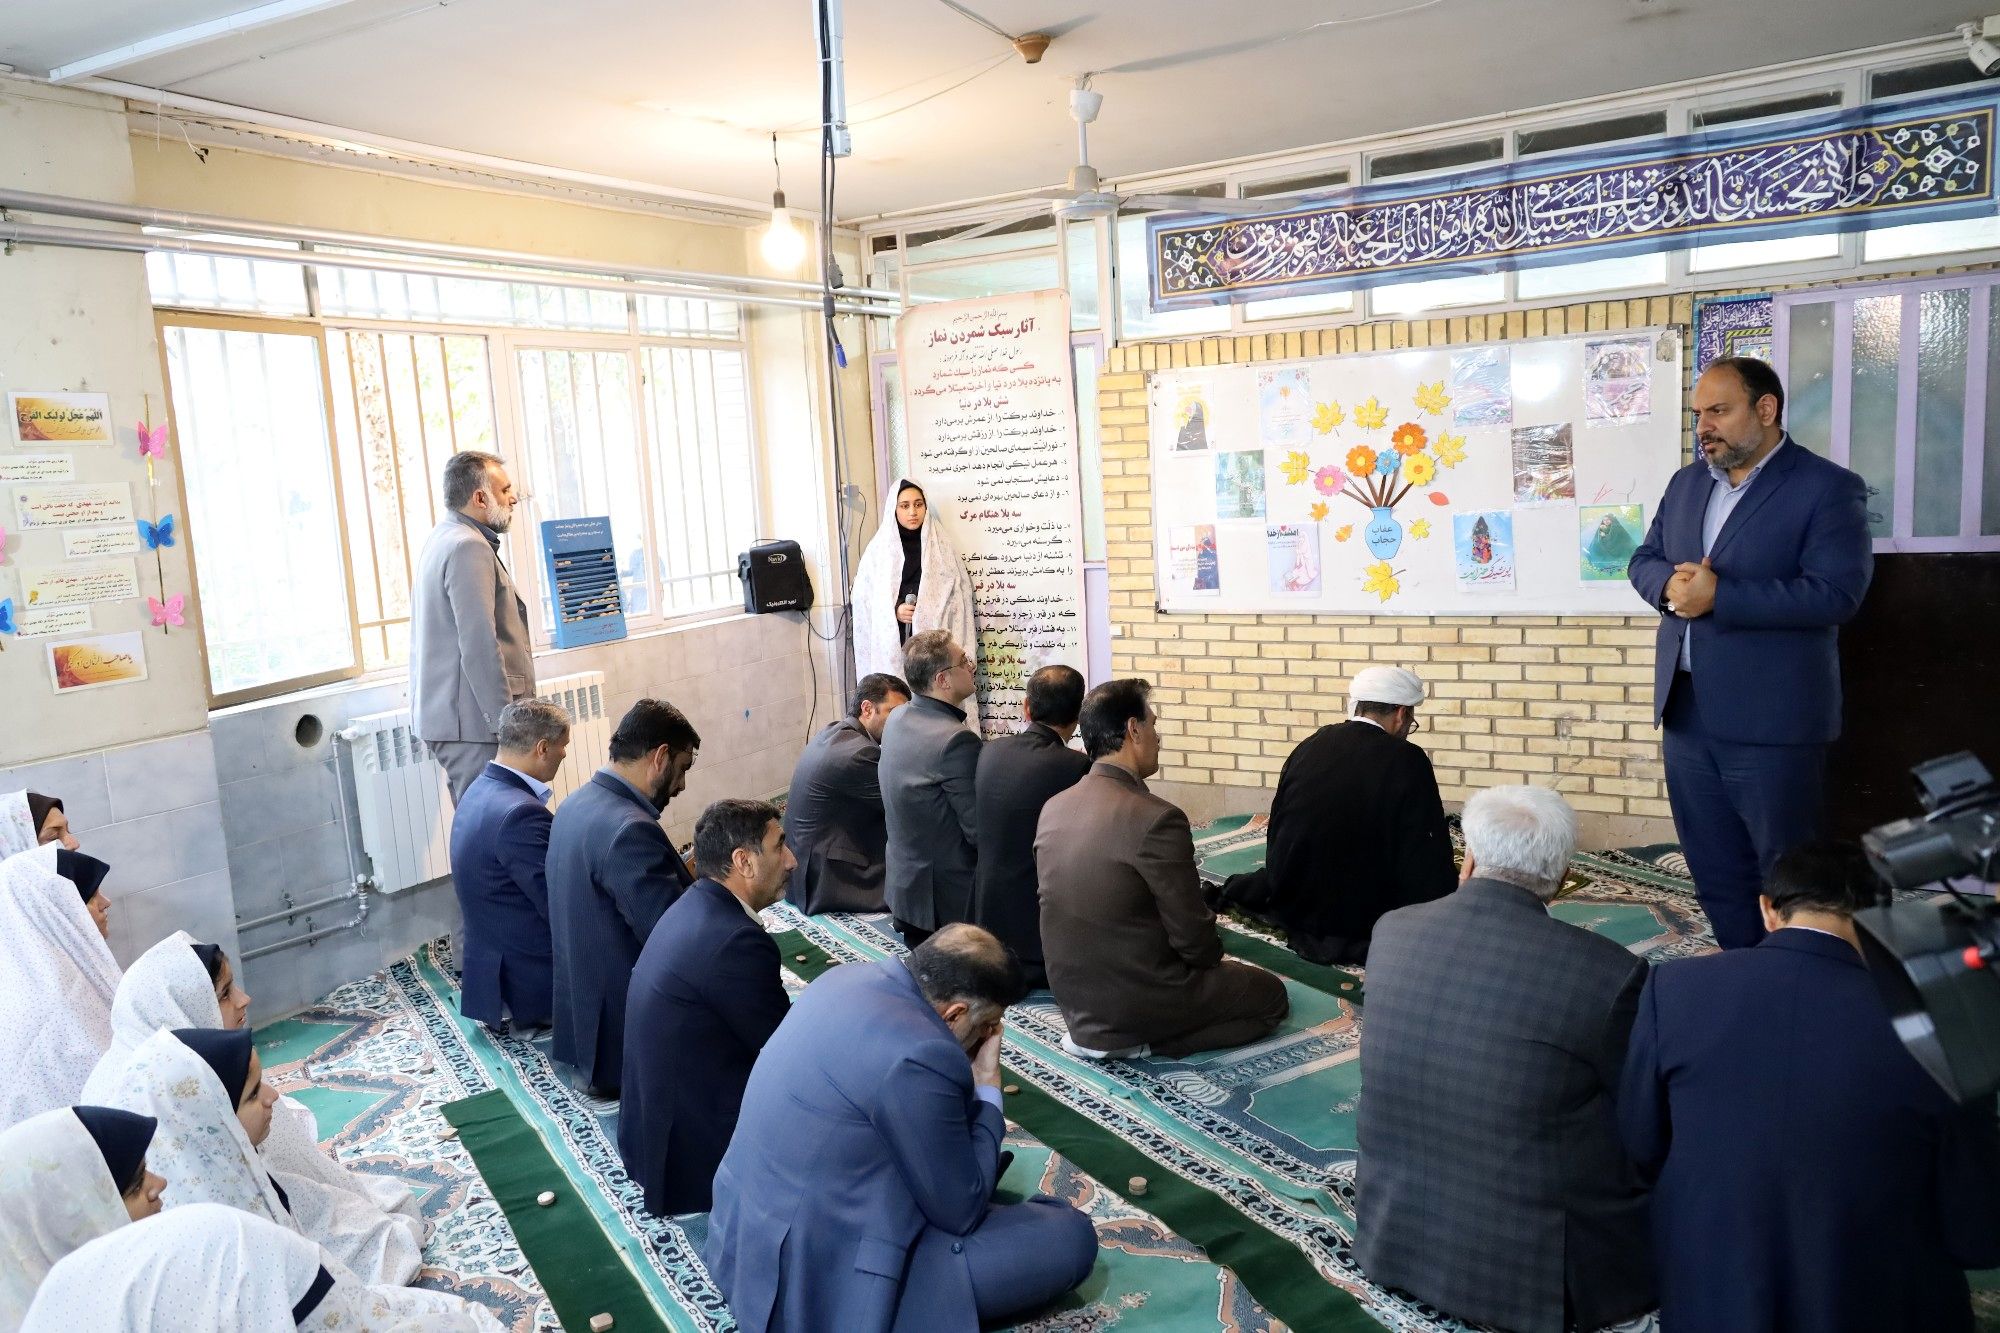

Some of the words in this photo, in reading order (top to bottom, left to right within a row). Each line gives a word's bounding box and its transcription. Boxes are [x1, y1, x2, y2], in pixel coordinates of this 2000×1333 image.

[988, 323, 1014, 340] سبک
[1014, 316, 1036, 339] آثار
[928, 328, 947, 348] نماز
[950, 325, 985, 345] شمردن
[959, 399, 971, 411] دنیا
[973, 399, 982, 411] در
[983, 396, 992, 408] بلا
[1002, 411, 1028, 423] برکت
[1028, 408, 1057, 421] خداوند
[1003, 428, 1029, 437] برکت
[1029, 424, 1057, 437] خداوند
[943, 447, 968, 458] گرفته
[981, 445, 1007, 456] صالحین
[953, 464, 971, 473] اجری
[986, 460, 1004, 470] انجام
[1005, 459, 1030, 470] نیکی
[1004, 475, 1034, 486] مستجاب
[1034, 474, 1059, 485] دعایش
[1004, 491, 1030, 501] صالحین
[1031, 491, 1048, 500] دعای
[959, 510, 977, 523] مرگ
[978, 509, 999, 521] هنگام
[1001, 508, 1009, 520] بلا
[1011, 510, 1021, 518] سه
[1013, 523, 1036, 533] خواری
[1056, 523, 1062, 532] با
[1033, 535, 1063, 547] گرسنه
[1371, 535, 1396, 546] حجاب
[767, 555, 783, 563] Navid
[967, 552, 982, 563] اگر
[983, 553, 998, 561] که
[1023, 553, 1036, 562] دنیا
[1044, 550, 1063, 559] تشنه
[985, 568, 1005, 577] عطش
[1029, 567, 1055, 577] کامش
[1056, 568, 1065, 576] به
[974, 580, 984, 593] قبر
[986, 582, 995, 593] در
[996, 580, 1004, 591] بلا
[982, 595, 1001, 606] قبرش
[1002, 597, 1009, 605] در
[1010, 595, 1035, 606] ملکی
[1036, 595, 1063, 605] خداوند
[1012, 611, 1017, 620] و
[1018, 610, 1033, 620] زجر
[1048, 612, 1055, 620] در
[1058, 610, 1076, 618] که
[1009, 624, 1027, 635] مبتلا
[1027, 624, 1037, 635] قبر
[1038, 623, 1055, 635] فشار
[1056, 625, 1066, 634] به
[986, 640, 998, 650] قبر
[998, 639, 1028, 650] تاریکی
[1033, 640, 1056, 649] ظلمت
[1056, 642, 1066, 651] به
[997, 655, 1006, 667] در
[1007, 654, 1016, 668] بلا
[1003, 669, 1010, 678] با
[1010, 670, 1016, 679] را
[1017, 669, 1023, 679] او
[1000, 712, 1022, 723] رحمت
